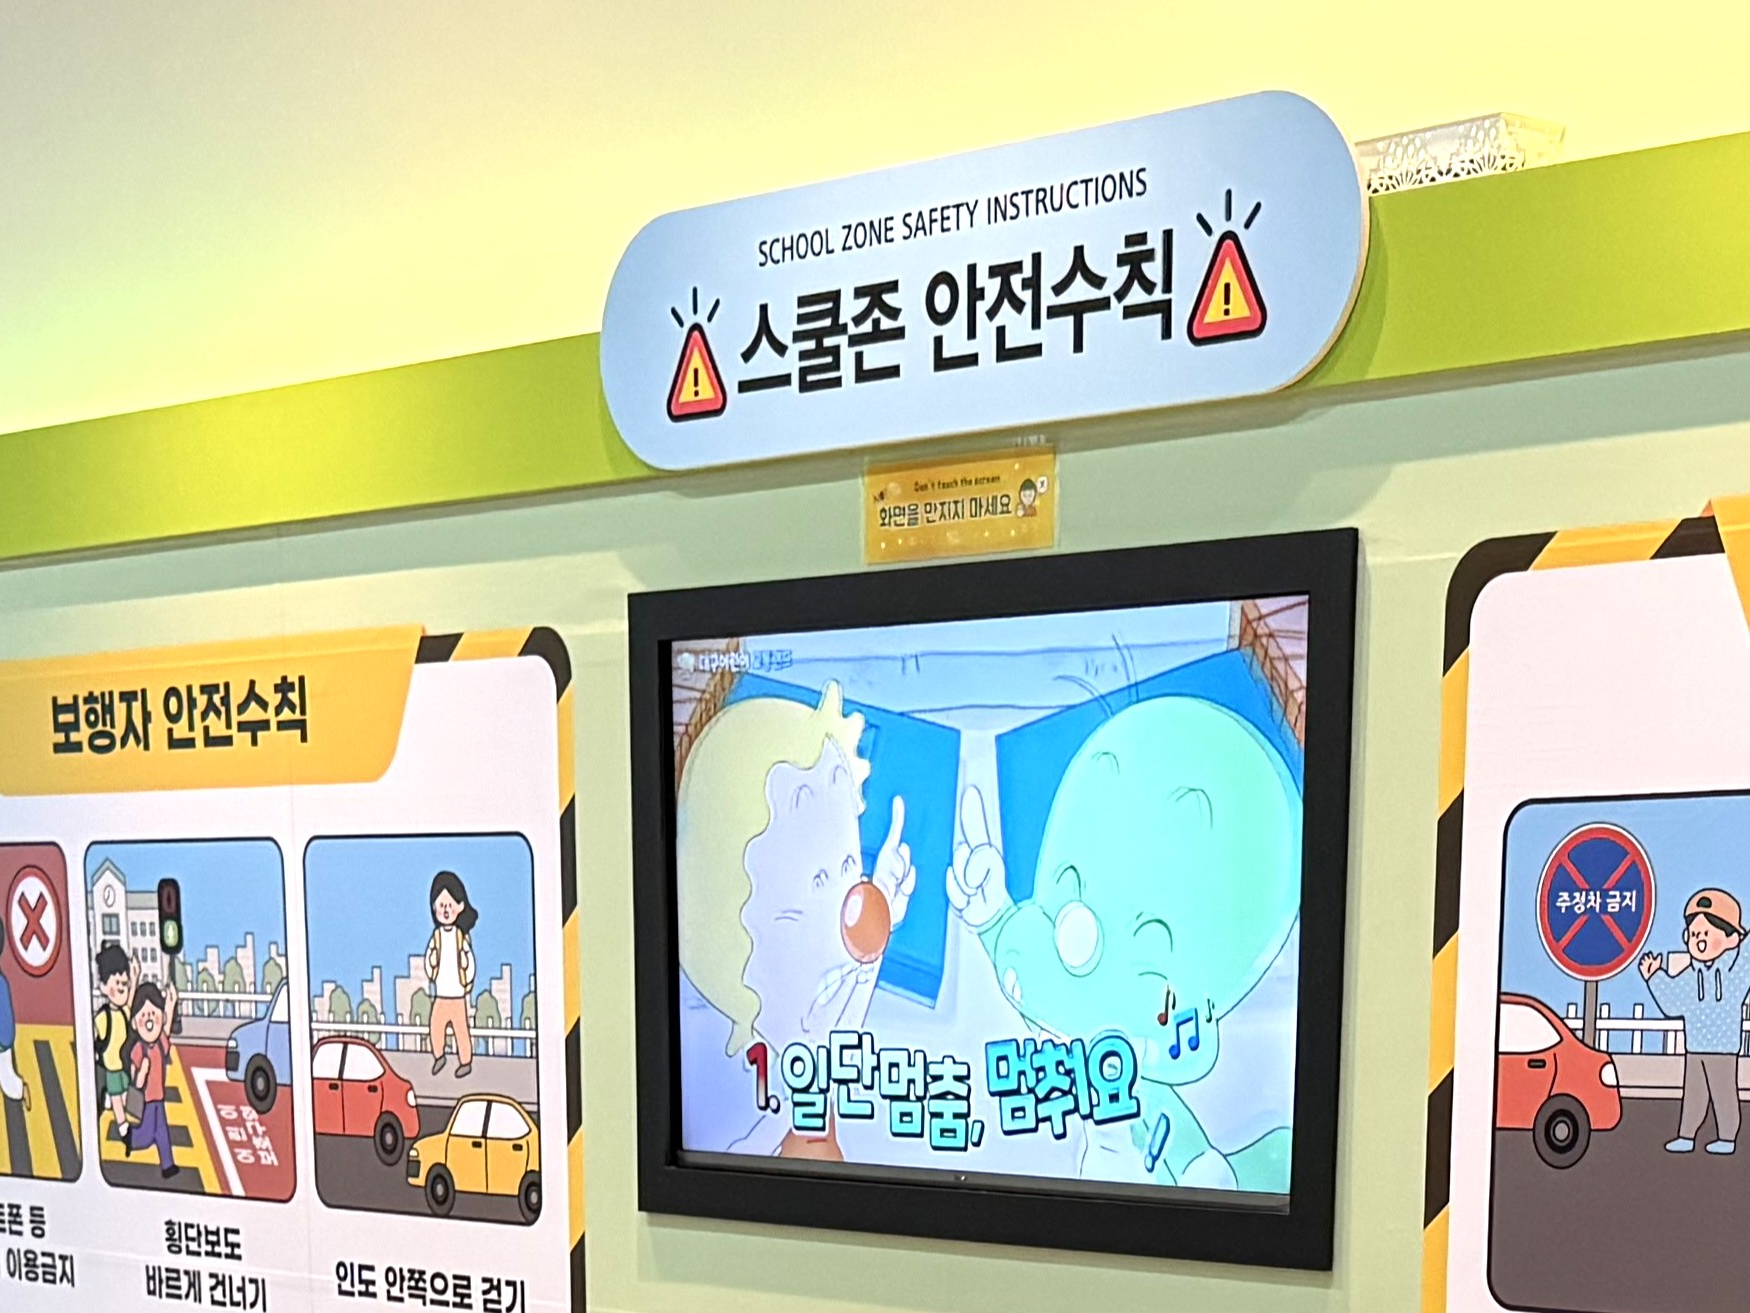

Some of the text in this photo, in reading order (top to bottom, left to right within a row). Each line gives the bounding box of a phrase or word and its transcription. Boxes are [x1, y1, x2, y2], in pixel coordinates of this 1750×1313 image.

[758, 166, 1148, 268] SCHOOL ZONE SAFETY INSTRUCTIONS
[737, 228, 1174, 394] 스쿨존 안전수칙
[938, 477, 958, 491] touch
[960, 476, 973, 488] the
[974, 475, 1001, 486] screen
[879, 493, 1012, 528] 화면을 만지지 마세요
[50, 673, 310, 756] 보행자 안전수칙
[1555, 889, 1637, 914] 주정차 금지
[28, 1204, 47, 1239] 등
[164, 1219, 243, 1262] 횡단보도
[5, 1246, 77, 1288] 이용금지
[335, 1260, 377, 1301] 인도
[144, 1264, 268, 1313] 바르게 건너기
